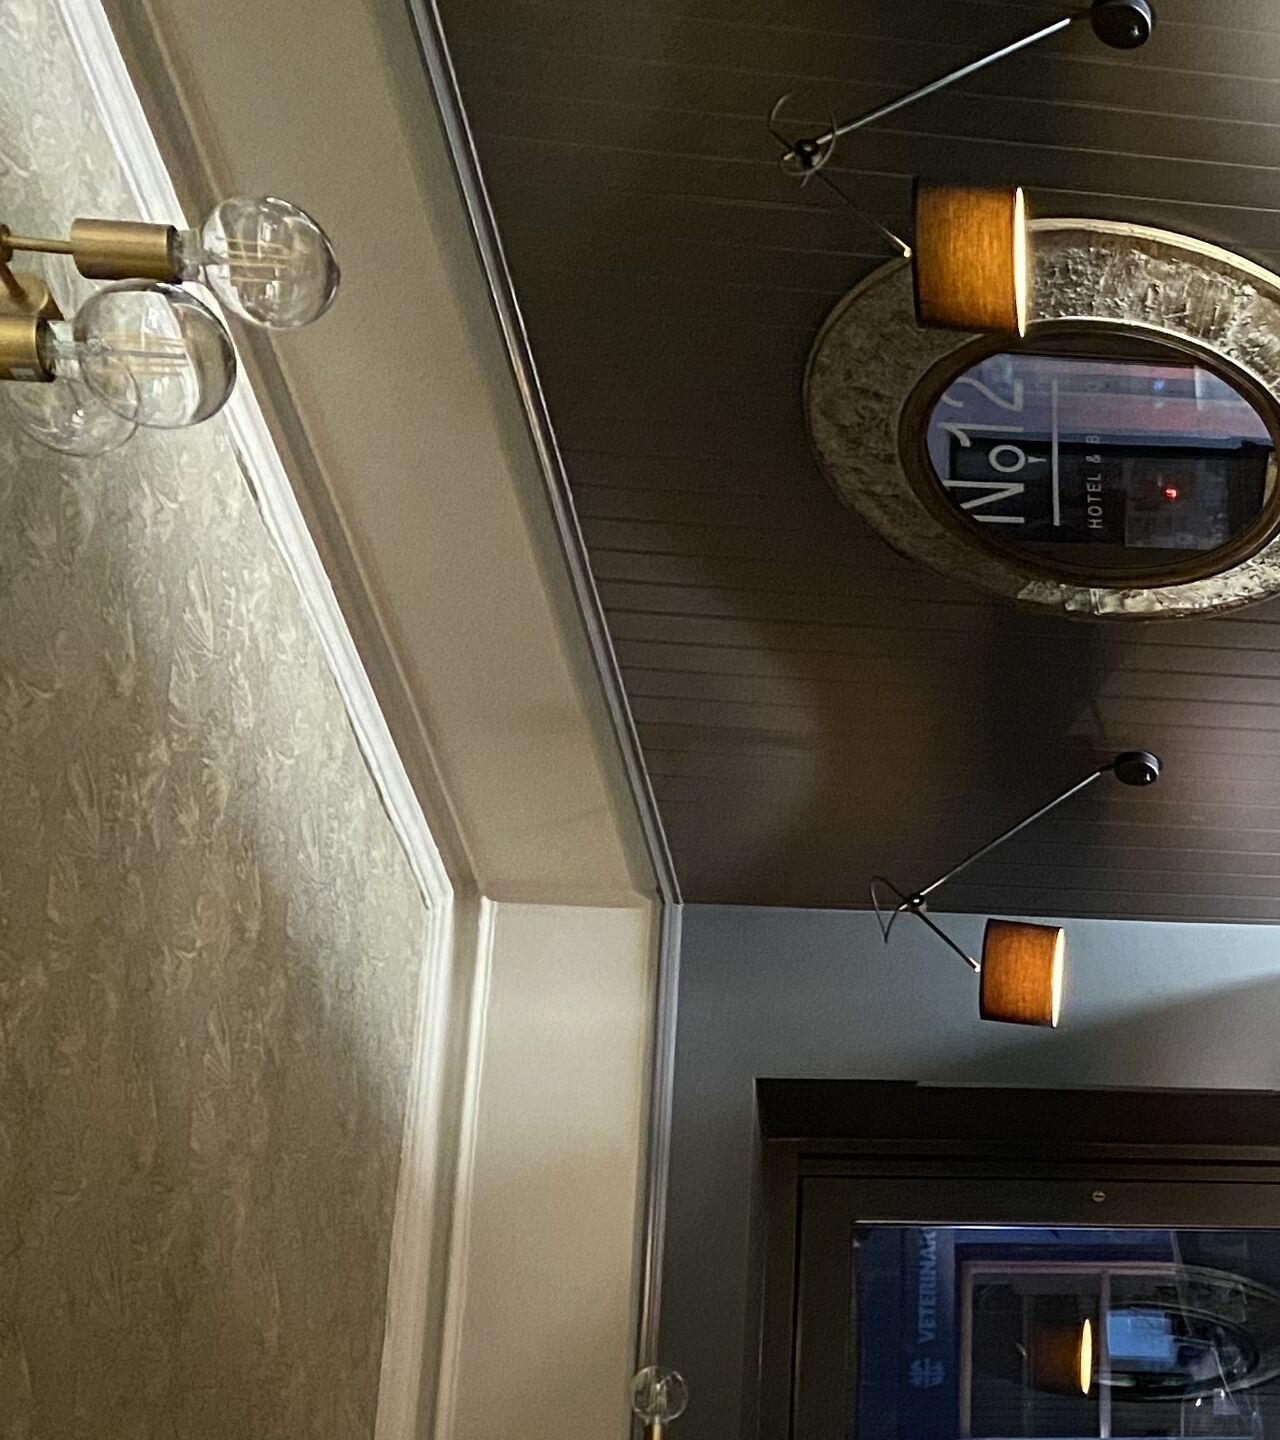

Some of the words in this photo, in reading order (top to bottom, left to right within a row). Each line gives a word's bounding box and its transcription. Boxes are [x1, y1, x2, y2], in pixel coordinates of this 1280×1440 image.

[1084, 452, 1101, 463] &
[1085, 471, 1104, 528] HOTEL
[916, 1226, 937, 1343] VETERINAR
